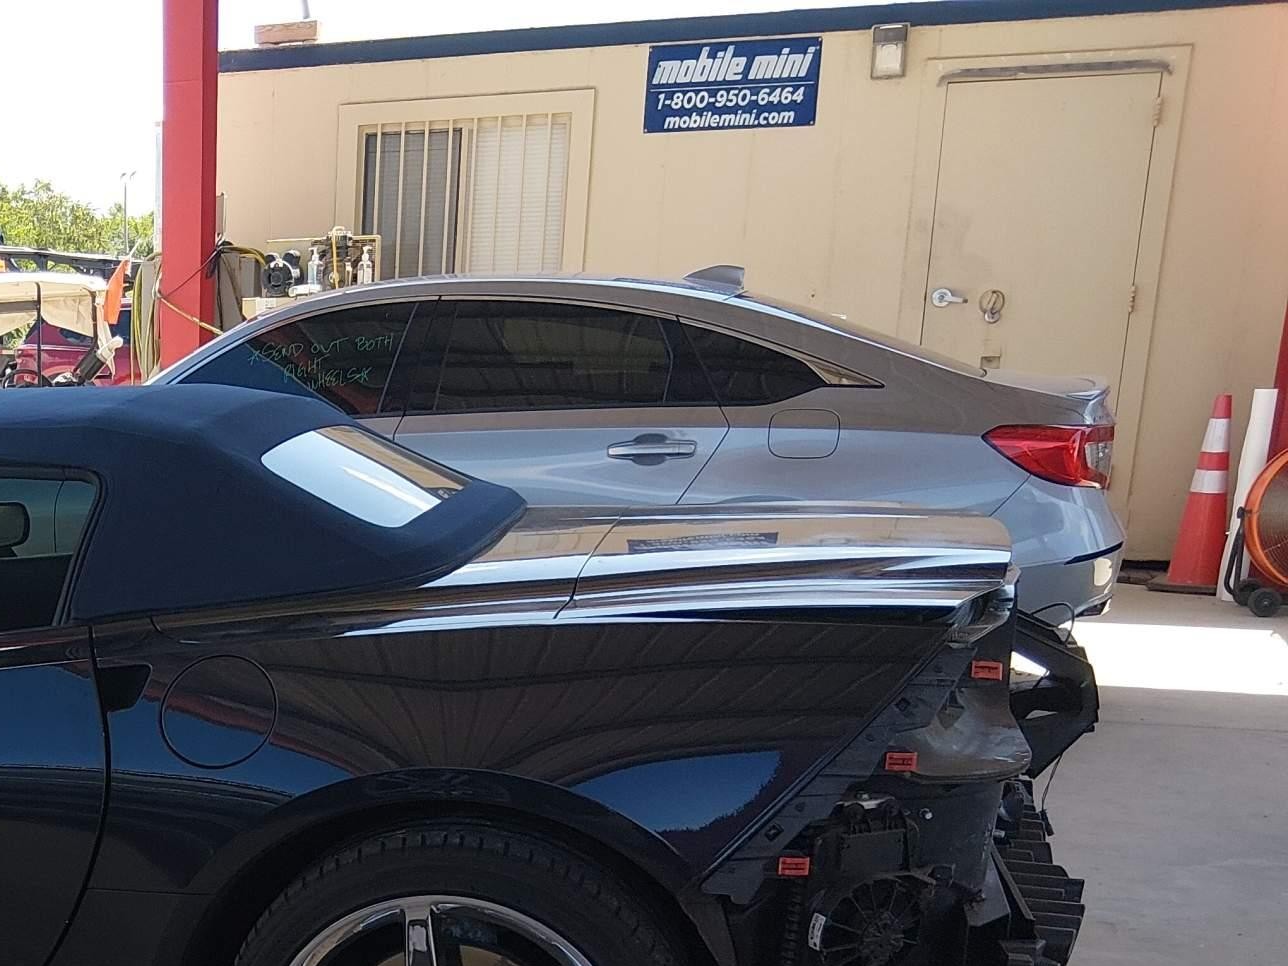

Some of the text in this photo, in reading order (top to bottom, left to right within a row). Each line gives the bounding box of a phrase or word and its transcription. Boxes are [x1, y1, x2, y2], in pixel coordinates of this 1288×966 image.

[652, 45, 815, 84] mobile mini
[657, 86, 805, 110] 1-800-950-6464
[664, 109, 795, 129] mobilemini.com
[312, 336, 349, 353] OUT
[355, 334, 393, 350] BOTH
[283, 354, 330, 382] RIGHT
